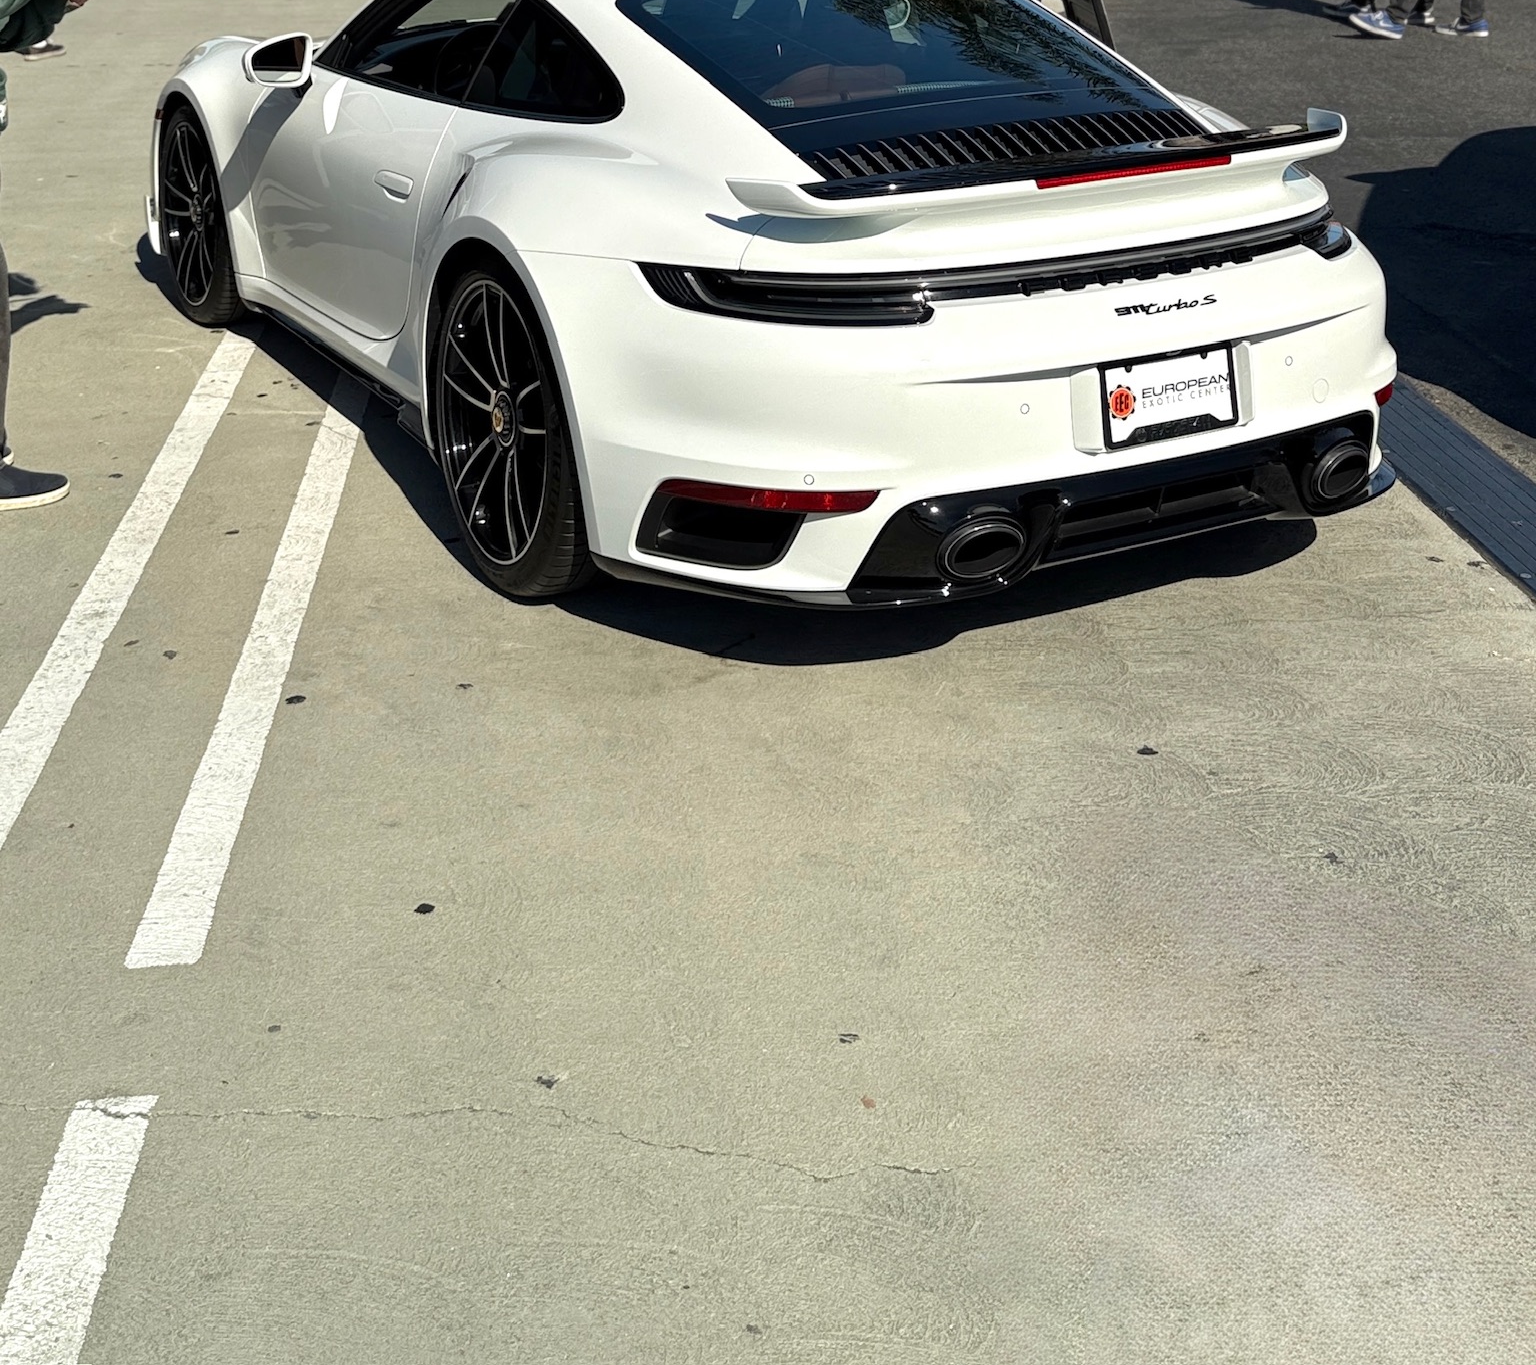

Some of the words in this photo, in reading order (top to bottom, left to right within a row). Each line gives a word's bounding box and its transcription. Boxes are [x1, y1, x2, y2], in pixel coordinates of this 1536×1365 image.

[1200, 294, 1217, 306] S
[1142, 372, 1230, 399] EUROPEAN
[1142, 393, 1183, 409] EXOTIC
[1190, 384, 1231, 400] CENTER
